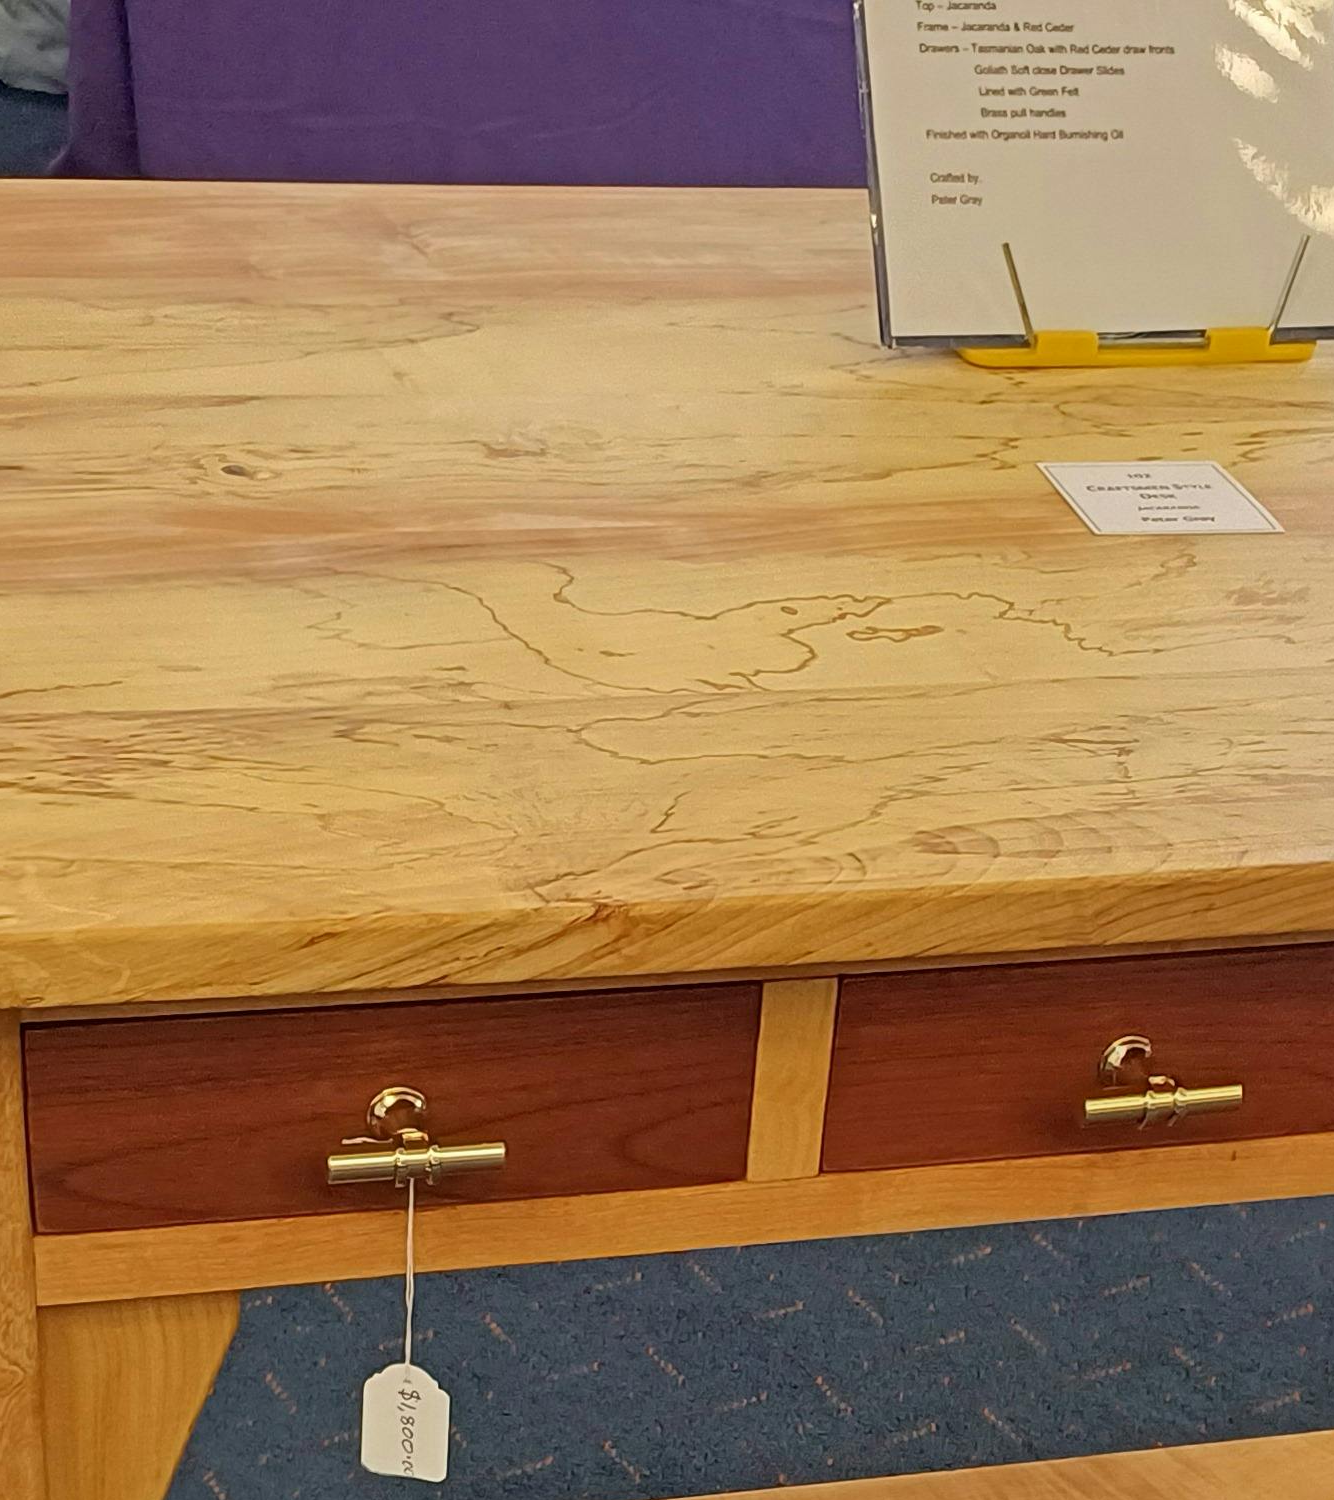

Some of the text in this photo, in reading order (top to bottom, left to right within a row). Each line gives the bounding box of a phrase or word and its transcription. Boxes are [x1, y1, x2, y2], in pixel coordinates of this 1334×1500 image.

[916, 0, 935, 12] Top
[947, 1, 997, 10] Jacaranda
[917, 21, 949, 31] Frame
[961, 22, 1011, 32] Jacaranda
[1013, 22, 1021, 32] &
[1023, 22, 1043, 32] Red
[919, 43, 960, 53] Drawers
[971, 43, 1024, 54] Tasmanian
[1026, 43, 1046, 53] Oak
[1048, 45, 1067, 54] with
[1069, 44, 1089, 54] Red
[1010, 65, 1030, 75] Soft
[1032, 66, 1057, 75] close
[1059, 65, 1094, 75] Drawer
[1096, 66, 1125, 75] Slides
[978, 86, 1080, 97] Lined with Green Felt
[980, 107, 1066, 119] Brass pull handles
[926, 129, 967, 139] Finished
[969, 130, 988, 139] with
[1033, 130, 1056, 139] Hard
[1058, 129, 1108, 141] Burnishing
[1110, 129, 1124, 140] Oil
[930, 172, 965, 183] Crafted
[931, 194, 983, 206] Peter Gray
